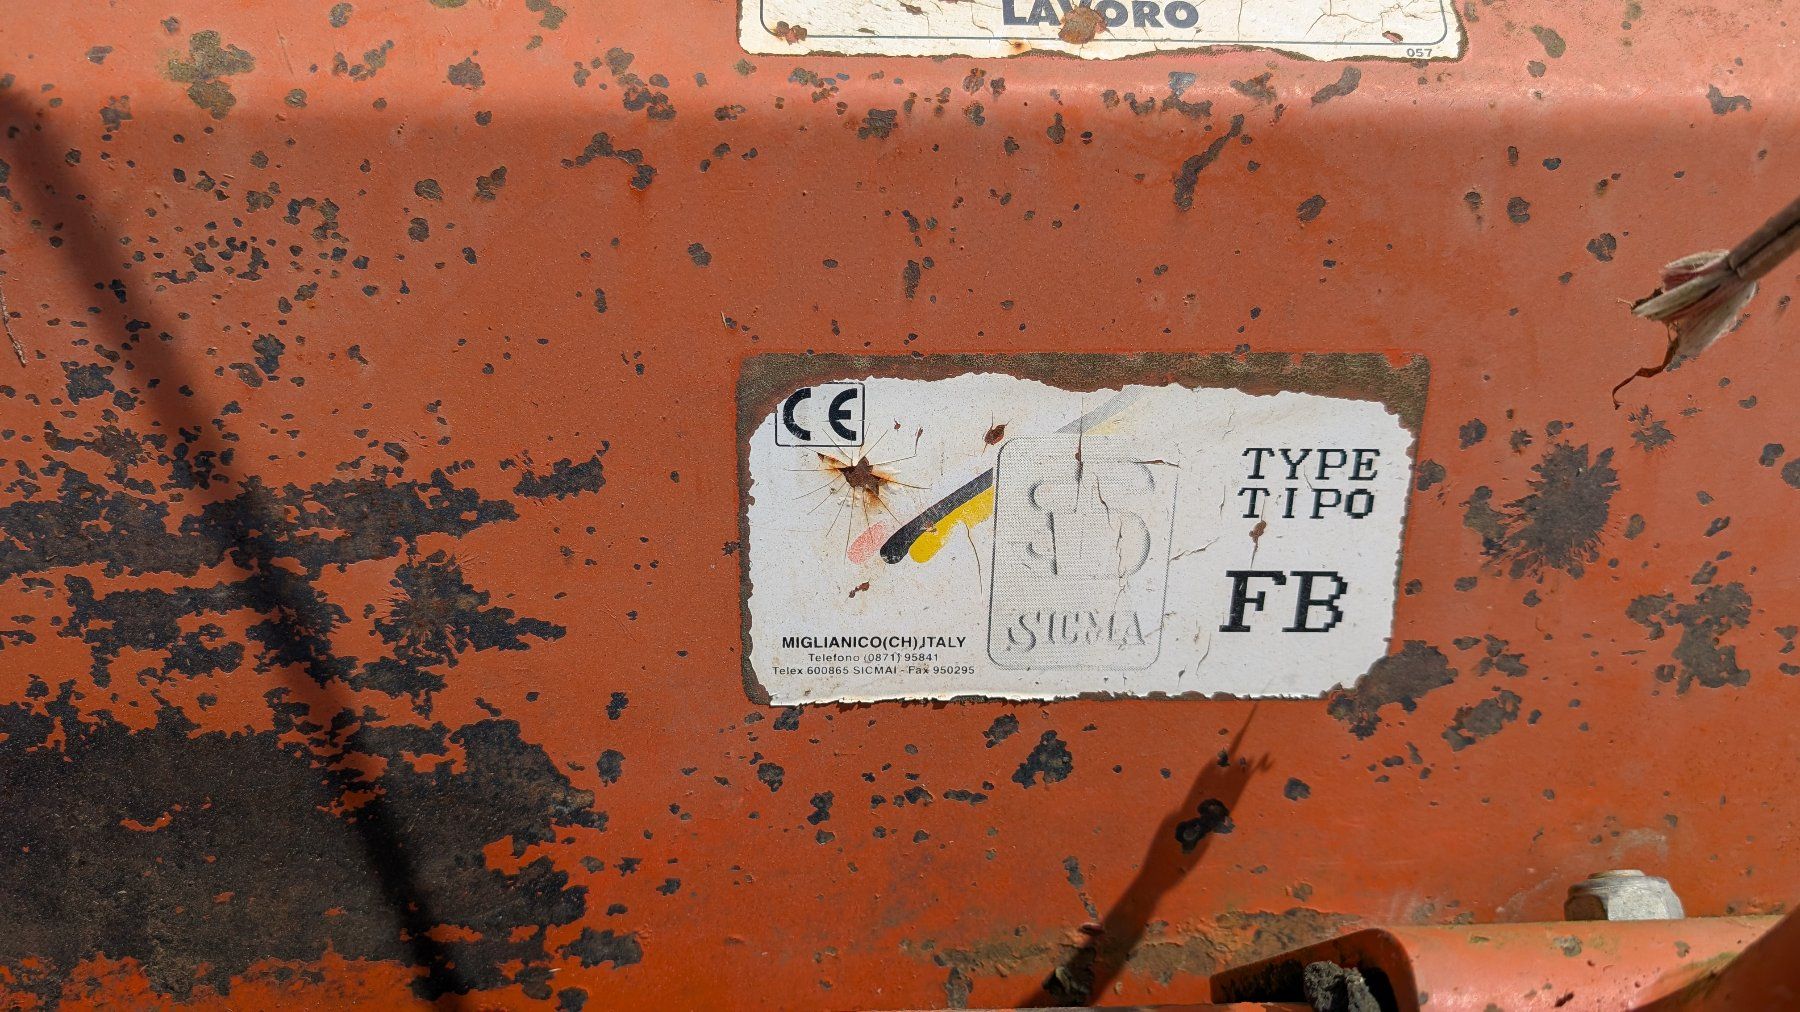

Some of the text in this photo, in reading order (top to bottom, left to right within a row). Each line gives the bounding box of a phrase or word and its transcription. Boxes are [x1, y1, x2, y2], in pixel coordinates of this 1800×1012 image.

[1406, 48, 1433, 57] 057
[1242, 447, 1381, 481] TYPE
[1237, 487, 1375, 519] TIPO
[1219, 570, 1348, 632] FB
[808, 652, 938, 663] Telefono (0871) 95841
[772, 666, 803, 675] Telex
[807, 666, 849, 675] 600865
[853, 666, 897, 675] SICMAI
[908, 666, 929, 675] Fax
[933, 665, 975, 675] 950295
